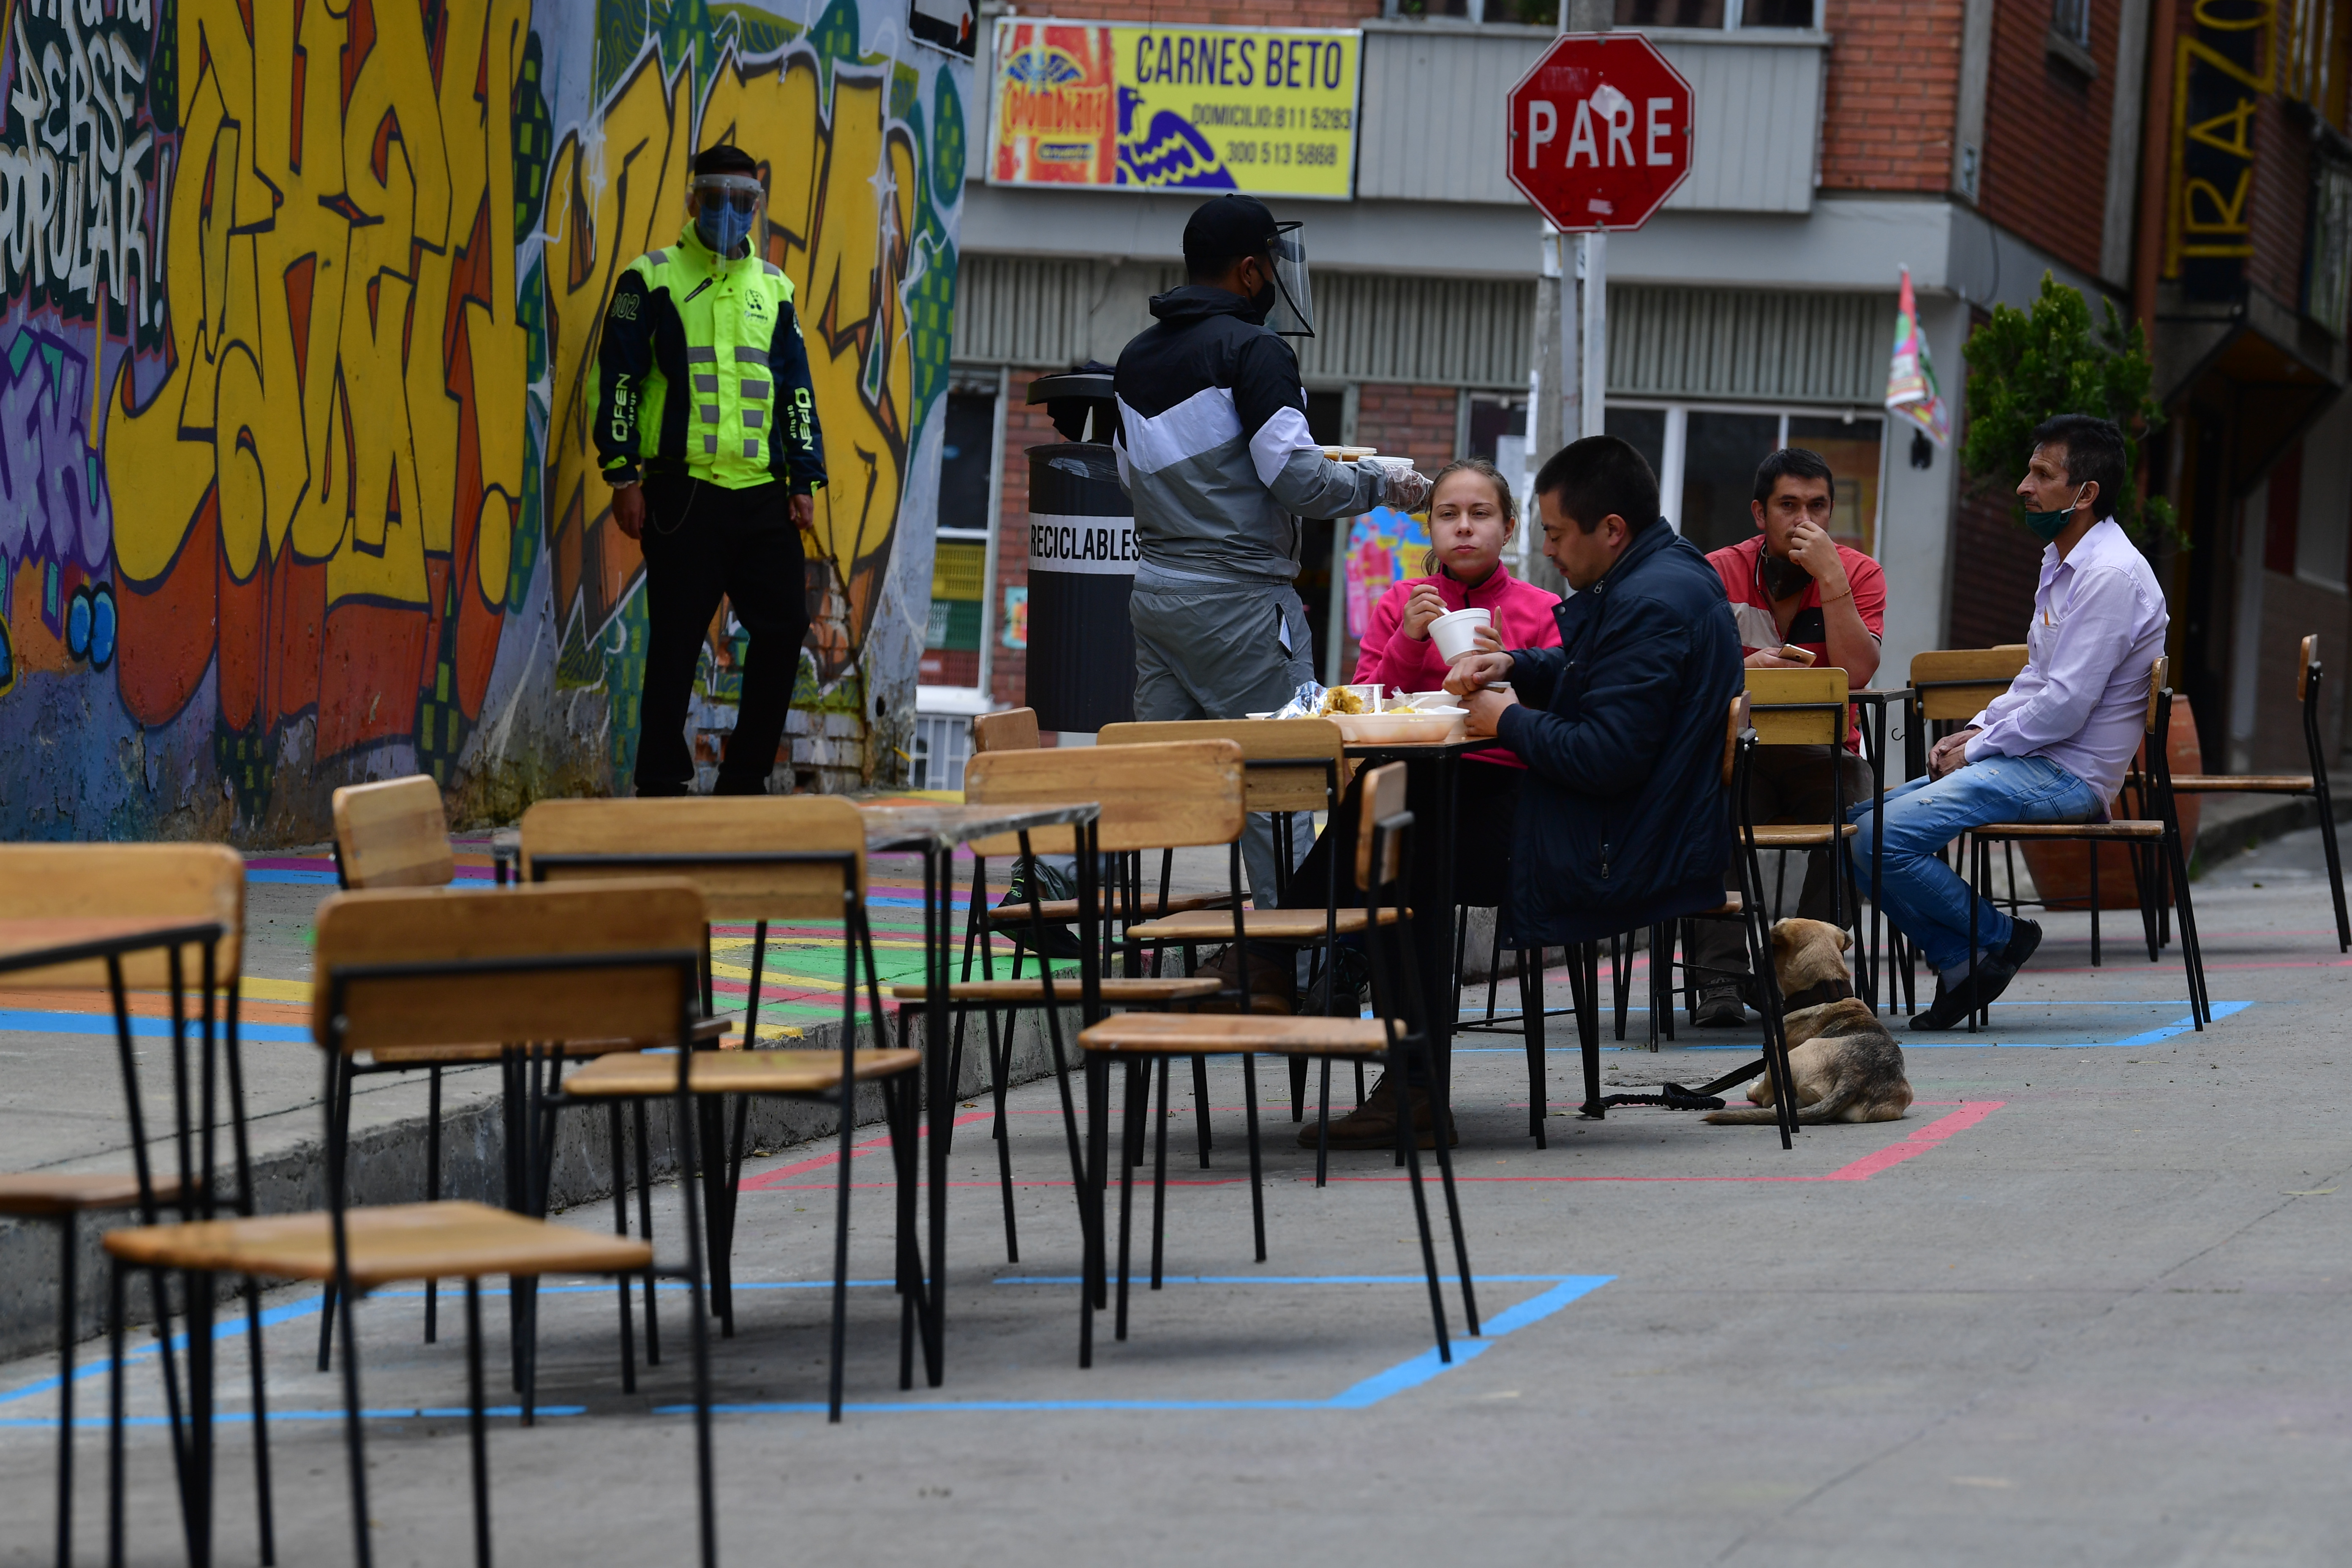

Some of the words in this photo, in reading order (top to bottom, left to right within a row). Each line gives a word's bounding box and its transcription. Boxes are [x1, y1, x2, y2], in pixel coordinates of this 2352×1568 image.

[1137, 35, 1256, 86] CARNES
[1266, 39, 1342, 89] BETO
[1227, 140, 1256, 164] 300
[1261, 141, 1292, 166] 513
[1527, 97, 1673, 169] PARE
[611, 373, 631, 442] OPEN
[795, 387, 814, 451] OPEN
[1030, 524, 1141, 561] RECICLABLES
